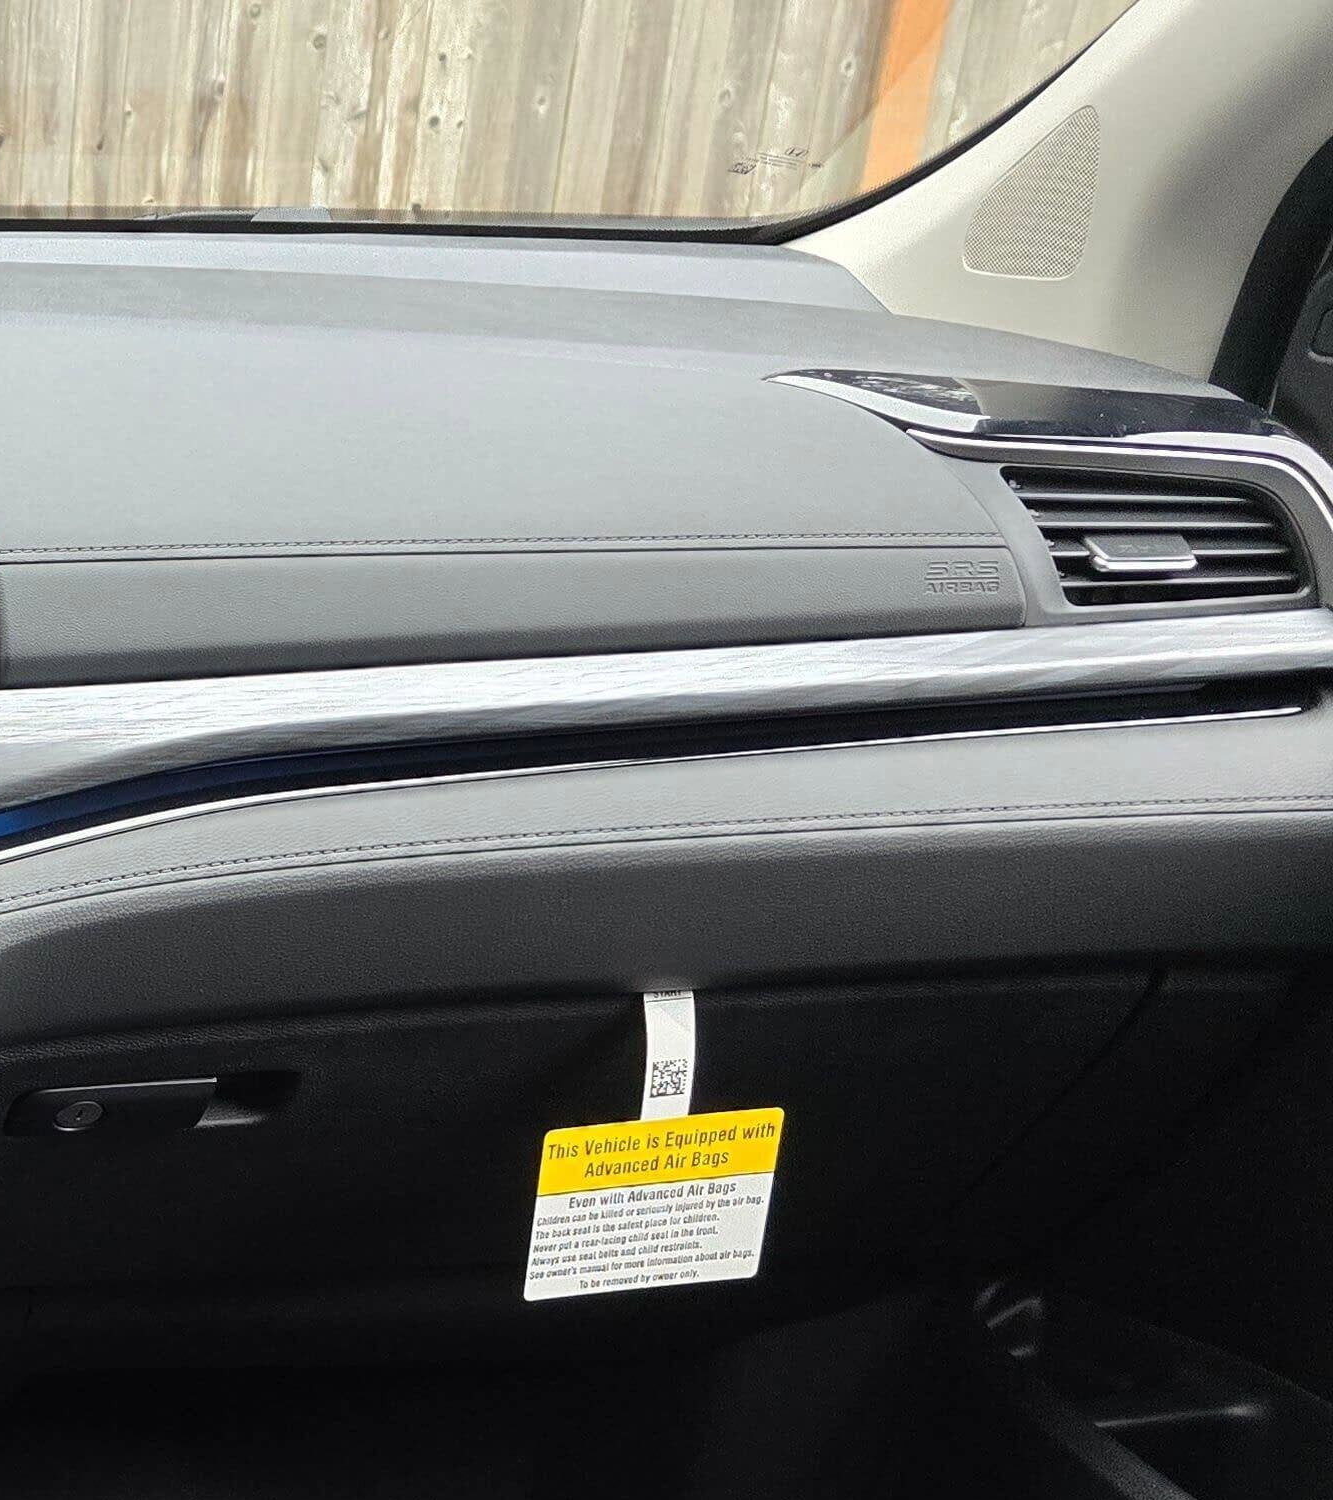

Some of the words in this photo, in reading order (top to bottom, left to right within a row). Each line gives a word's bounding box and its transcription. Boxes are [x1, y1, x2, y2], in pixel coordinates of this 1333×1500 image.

[925, 561, 999, 577] SRS
[924, 582, 999, 594] AIRBAG
[549, 1143, 579, 1160] This
[585, 1136, 640, 1156] Vehicle
[647, 1134, 659, 1149] is
[665, 1126, 737, 1149] Equipped
[743, 1122, 775, 1139] with
[585, 1156, 659, 1178] Advanced
[664, 1154, 687, 1169] Air
[692, 1152, 729, 1168] Bags
[569, 1197, 596, 1208] Even
[601, 1192, 624, 1205] with
[627, 1186, 683, 1203] Advanced
[687, 1185, 704, 1198] Air
[708, 1182, 737, 1195] Bags
[537, 1215, 570, 1227] Children
[572, 1214, 586, 1222] can
[589, 1212, 598, 1220] be
[601, 1208, 624, 1219] killed
[675, 1201, 703, 1213] injured
[706, 1200, 715, 1210] by
[717, 1198, 730, 1208] the
[733, 1196, 744, 1206] air
[746, 1195, 764, 1205] bag.
[536, 1231, 549, 1240] The
[683, 1213, 719, 1224] children.
